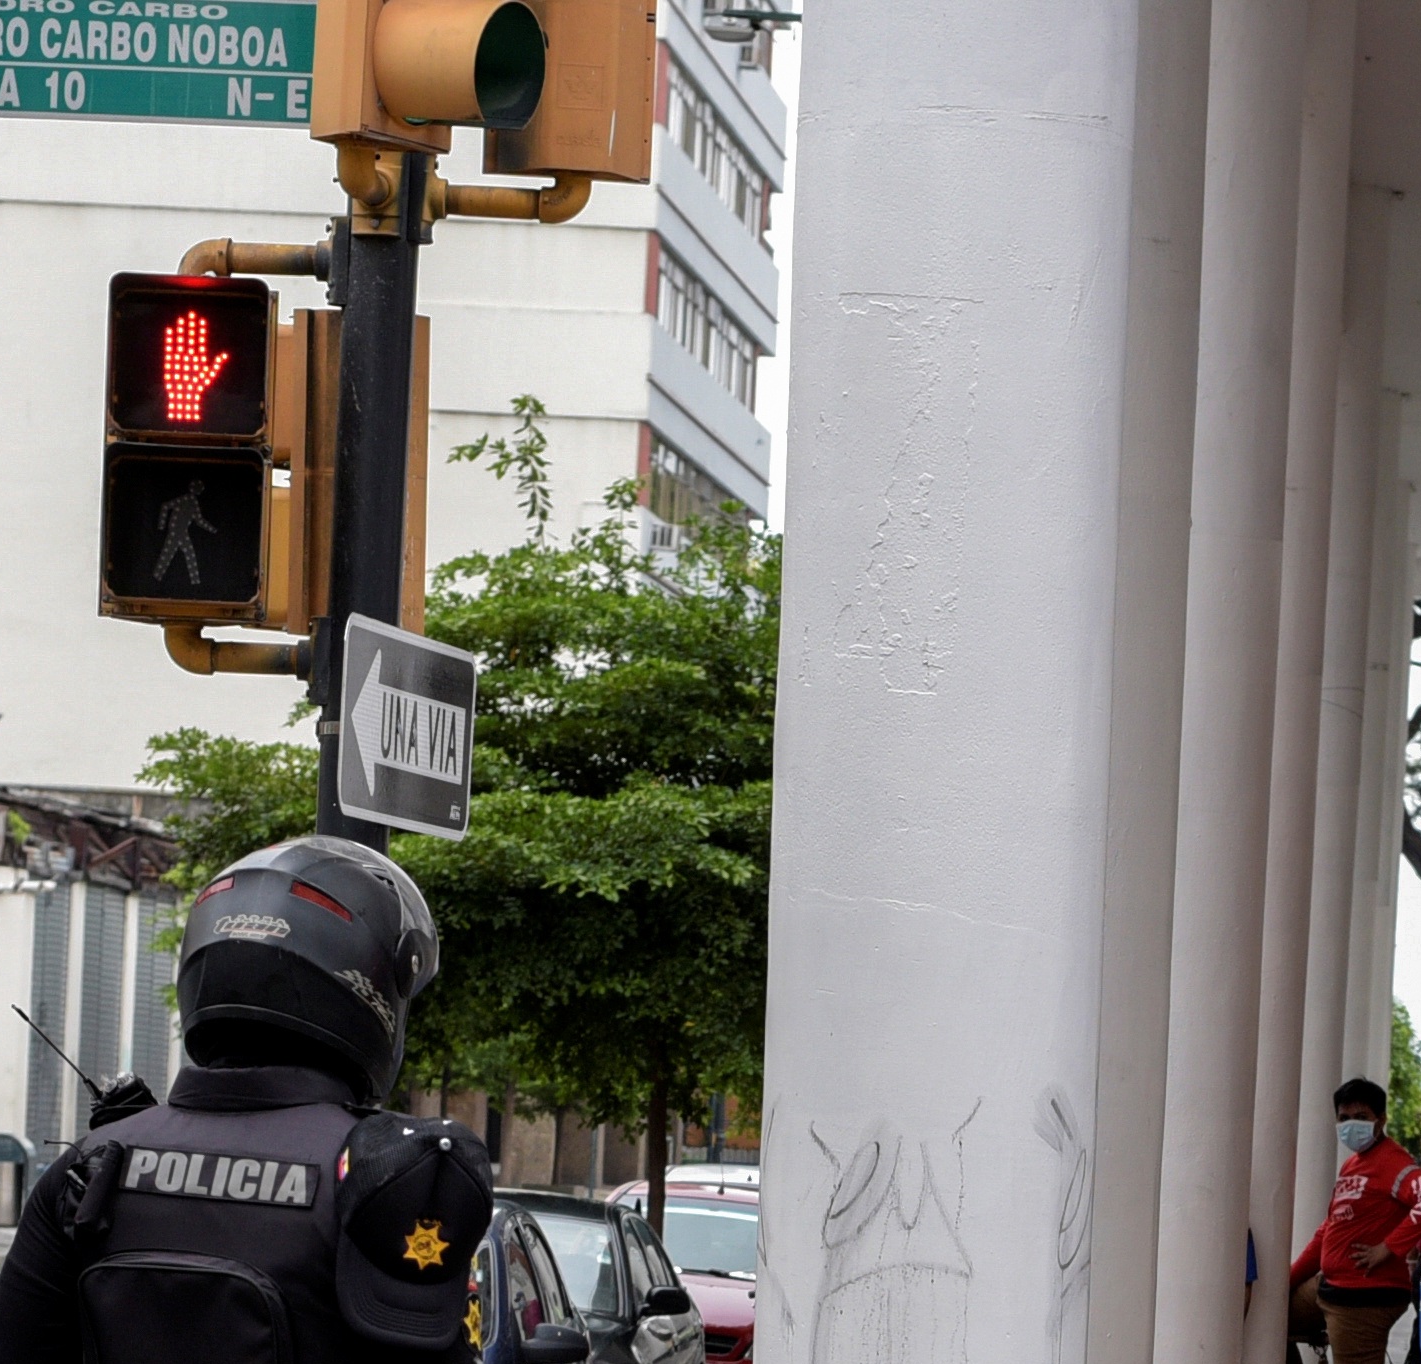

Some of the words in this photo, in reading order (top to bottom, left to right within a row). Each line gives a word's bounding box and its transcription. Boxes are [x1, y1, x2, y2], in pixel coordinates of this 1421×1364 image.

[89, 3, 228, 20] CARBO
[40, 18, 157, 62] CARBO
[168, 23, 288, 68] NOBOA
[45, 70, 86, 111] 10
[381, 691, 419, 767] UNA
[429, 704, 457, 776] VIA
[125, 1148, 307, 1204] POLICIA
